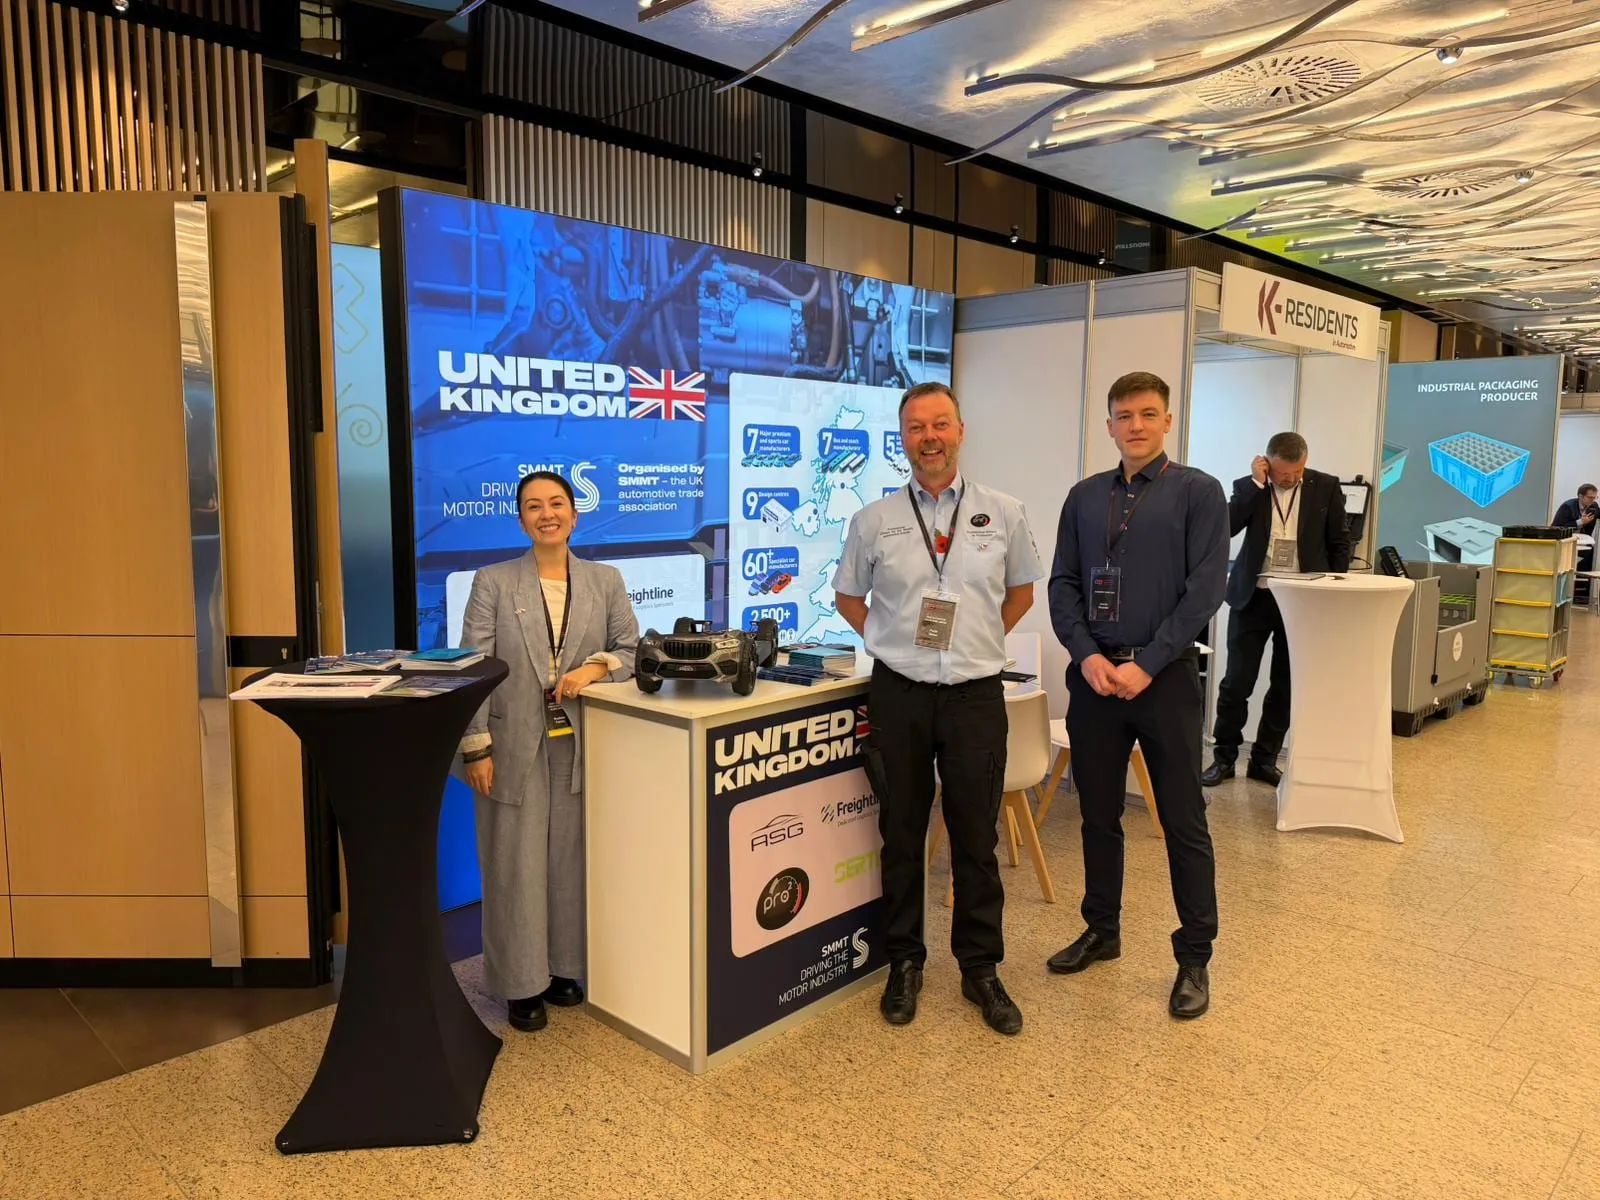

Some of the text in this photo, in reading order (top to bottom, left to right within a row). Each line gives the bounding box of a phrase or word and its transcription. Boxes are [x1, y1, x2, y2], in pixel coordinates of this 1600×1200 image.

[438, 350, 626, 393] UNITED
[1417, 379, 1539, 393] INDUSTRIAL PACKAGING
[1480, 391, 1538, 402] PRODUCER
[439, 386, 626, 418] KINGDOM
[747, 428, 759, 454] 7
[822, 432, 833, 456] 7
[618, 463, 705, 475] Organised by
[618, 476, 660, 486] SMMT
[670, 476, 687, 486] the
[688, 476, 704, 486] UK
[481, 482, 519, 497] DRIVI
[618, 489, 705, 499] automotive trade
[443, 501, 495, 517] MOTOR
[618, 502, 678, 512] association
[746, 491, 759, 516] 9
[627, 587, 674, 604] eightline
[715, 709, 855, 767] UNITED
[714, 736, 854, 795] KINGDOM
[751, 822, 804, 852] ASG
[834, 850, 880, 884] SERT
[821, 935, 849, 957] SMMT
[801, 949, 849, 981] DRIVING THE
[779, 962, 849, 1006] MOTOR INDUSTRY
